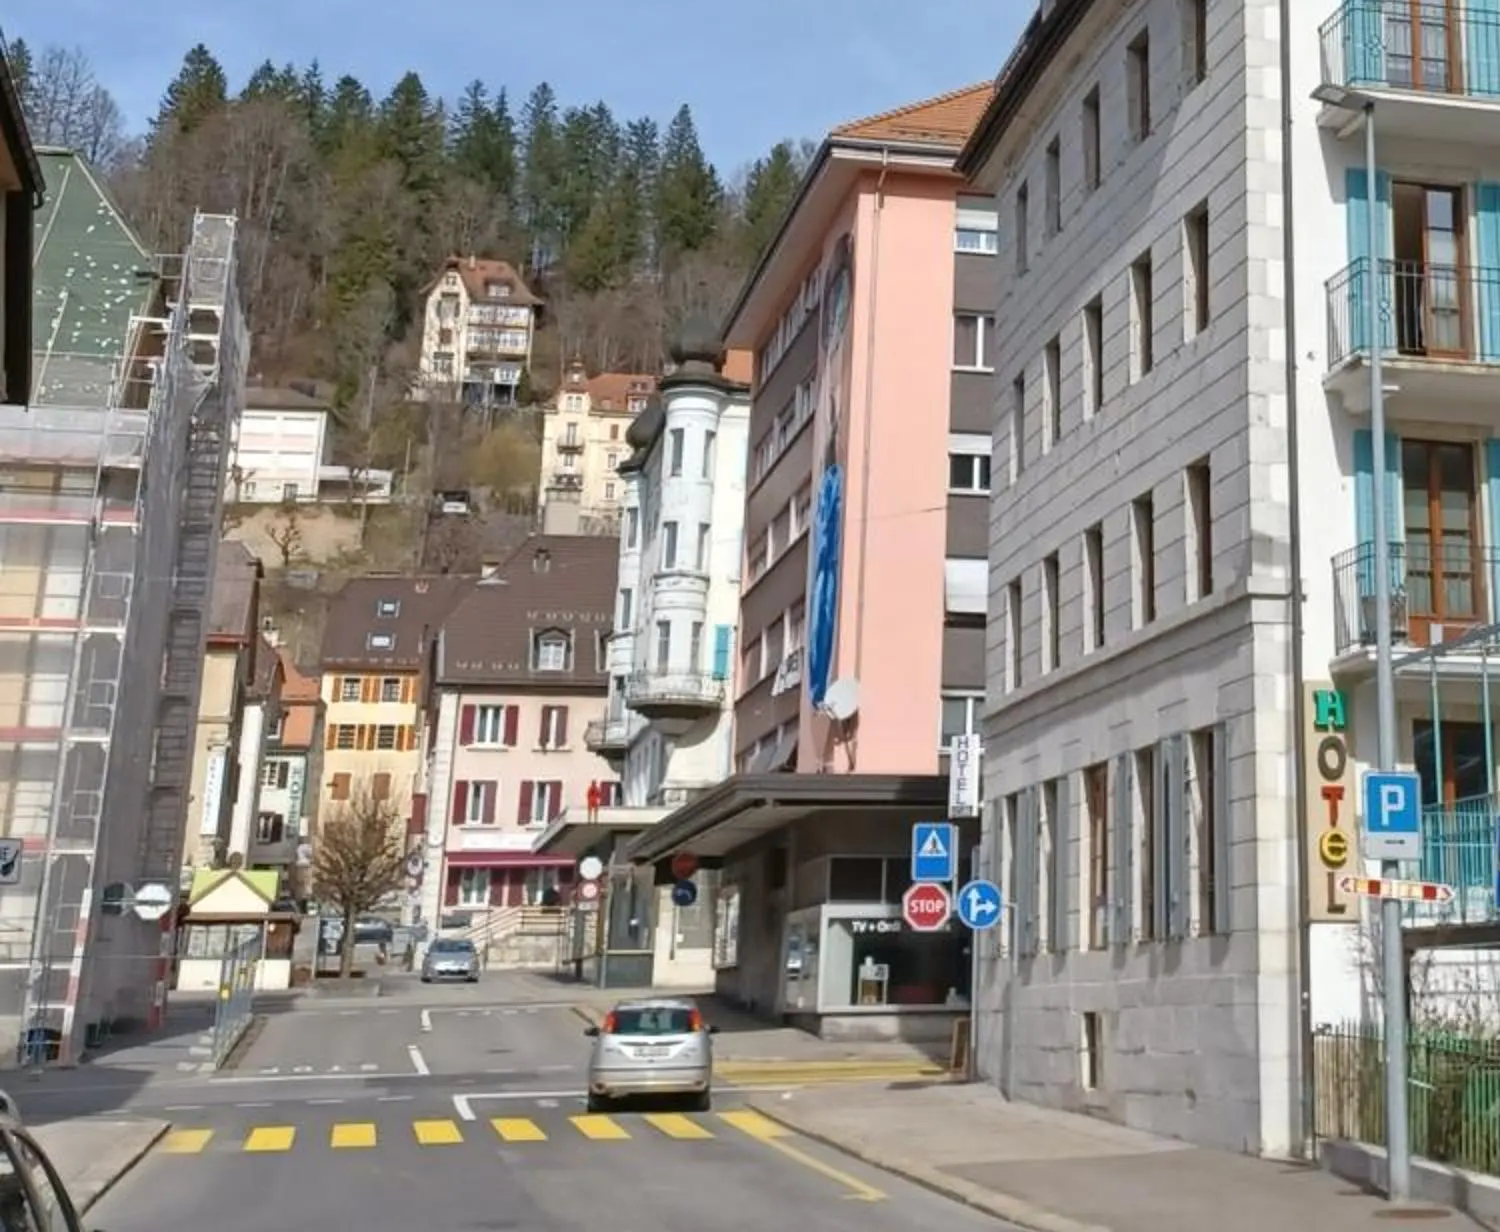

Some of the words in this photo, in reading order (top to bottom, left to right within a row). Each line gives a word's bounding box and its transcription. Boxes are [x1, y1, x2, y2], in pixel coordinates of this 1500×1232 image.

[956, 735, 969, 805] HOTEL
[1379, 784, 1405, 827] P
[910, 899, 945, 913] STOP
[852, 920, 867, 932] TV
